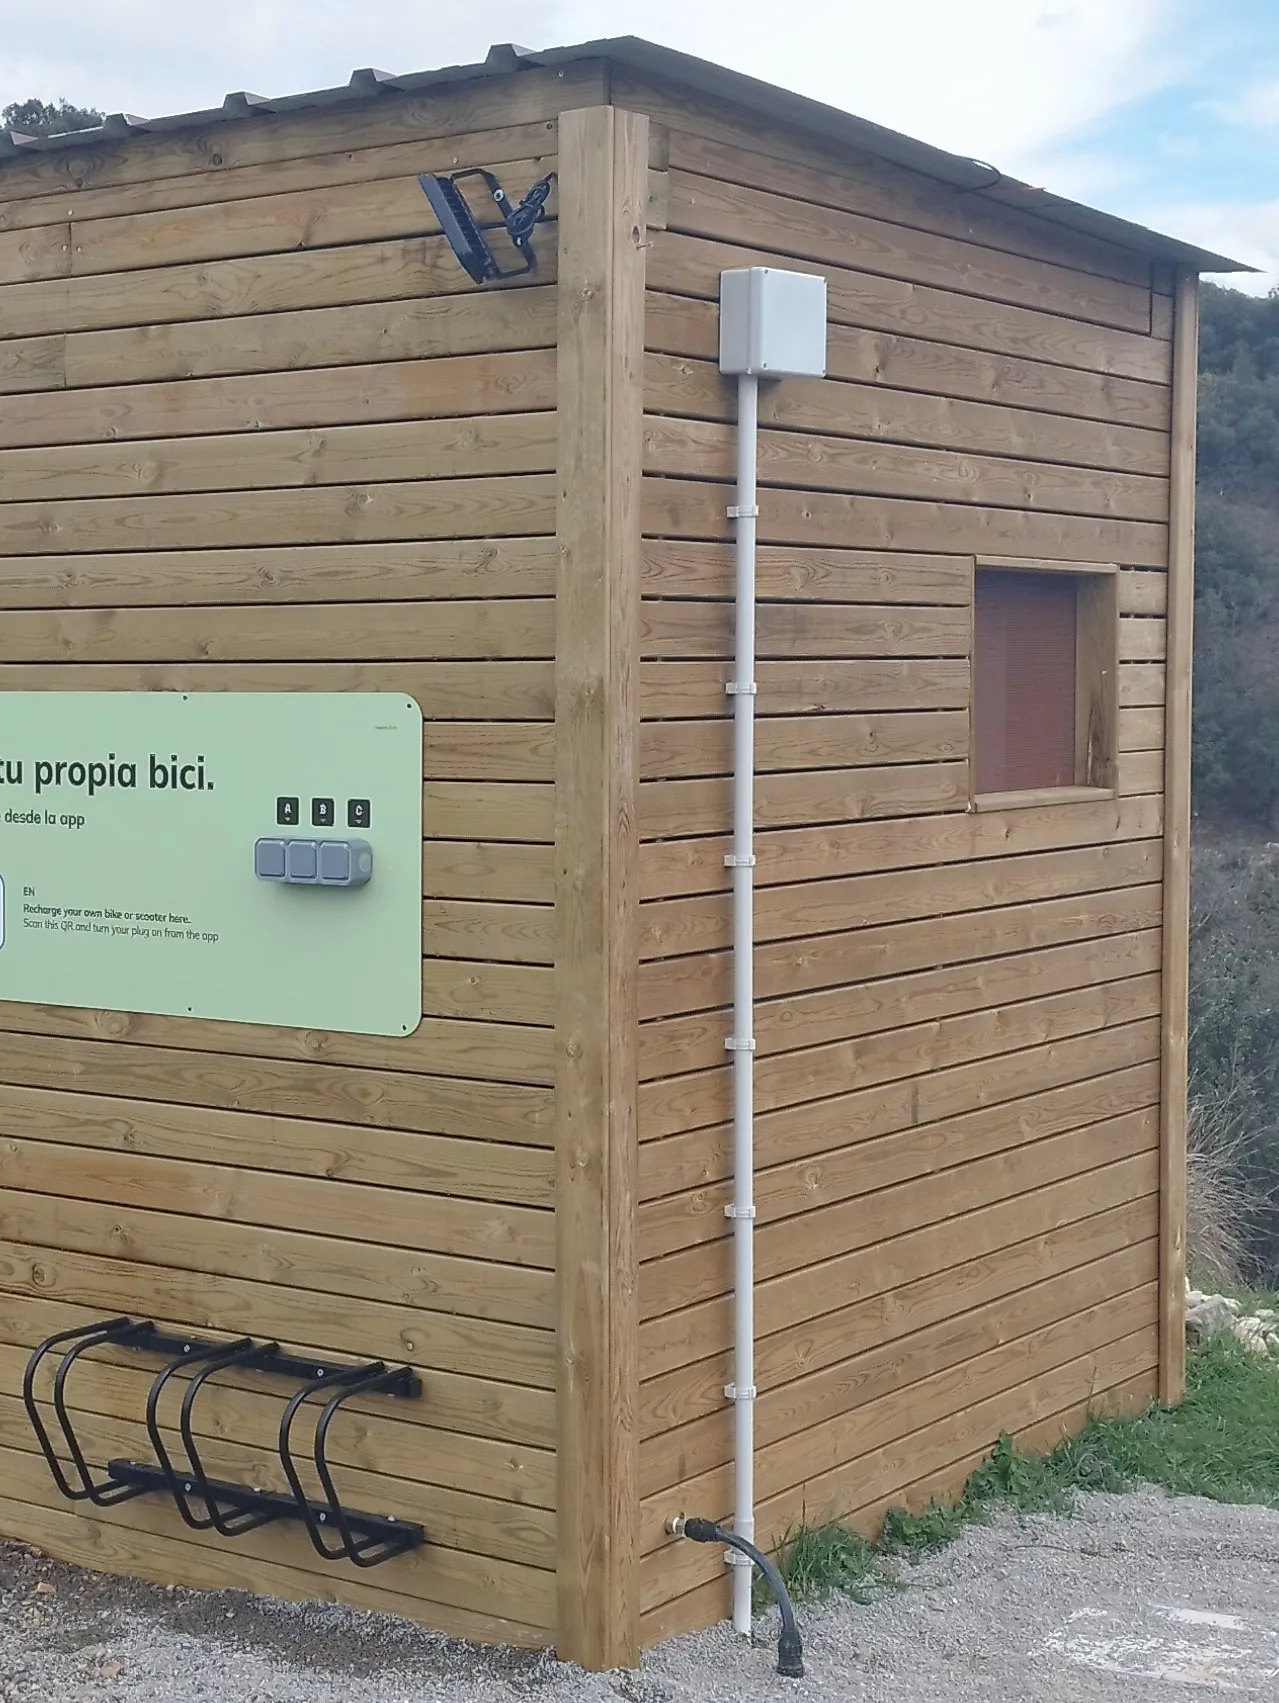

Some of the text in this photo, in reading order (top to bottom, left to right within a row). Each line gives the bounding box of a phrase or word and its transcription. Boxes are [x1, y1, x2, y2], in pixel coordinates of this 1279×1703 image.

[35, 753, 137, 796] propia
[149, 753, 214, 790] bici.
[284, 803, 292, 814] A
[319, 803, 327, 815] B
[355, 804, 364, 816] C
[5, 808, 41, 824] desde
[45, 809, 56, 825] la
[60, 813, 85, 829] app
[23, 887, 35, 896] EN
[23, 904, 62, 917] Recharge
[63, 908, 82, 918] your
[84, 909, 102, 918] own
[104, 908, 122, 919] bike
[124, 912, 134, 920] or
[135, 913, 167, 922] scooter
[23, 918, 219, 943] Scan this QR and turn your plug on from the app
